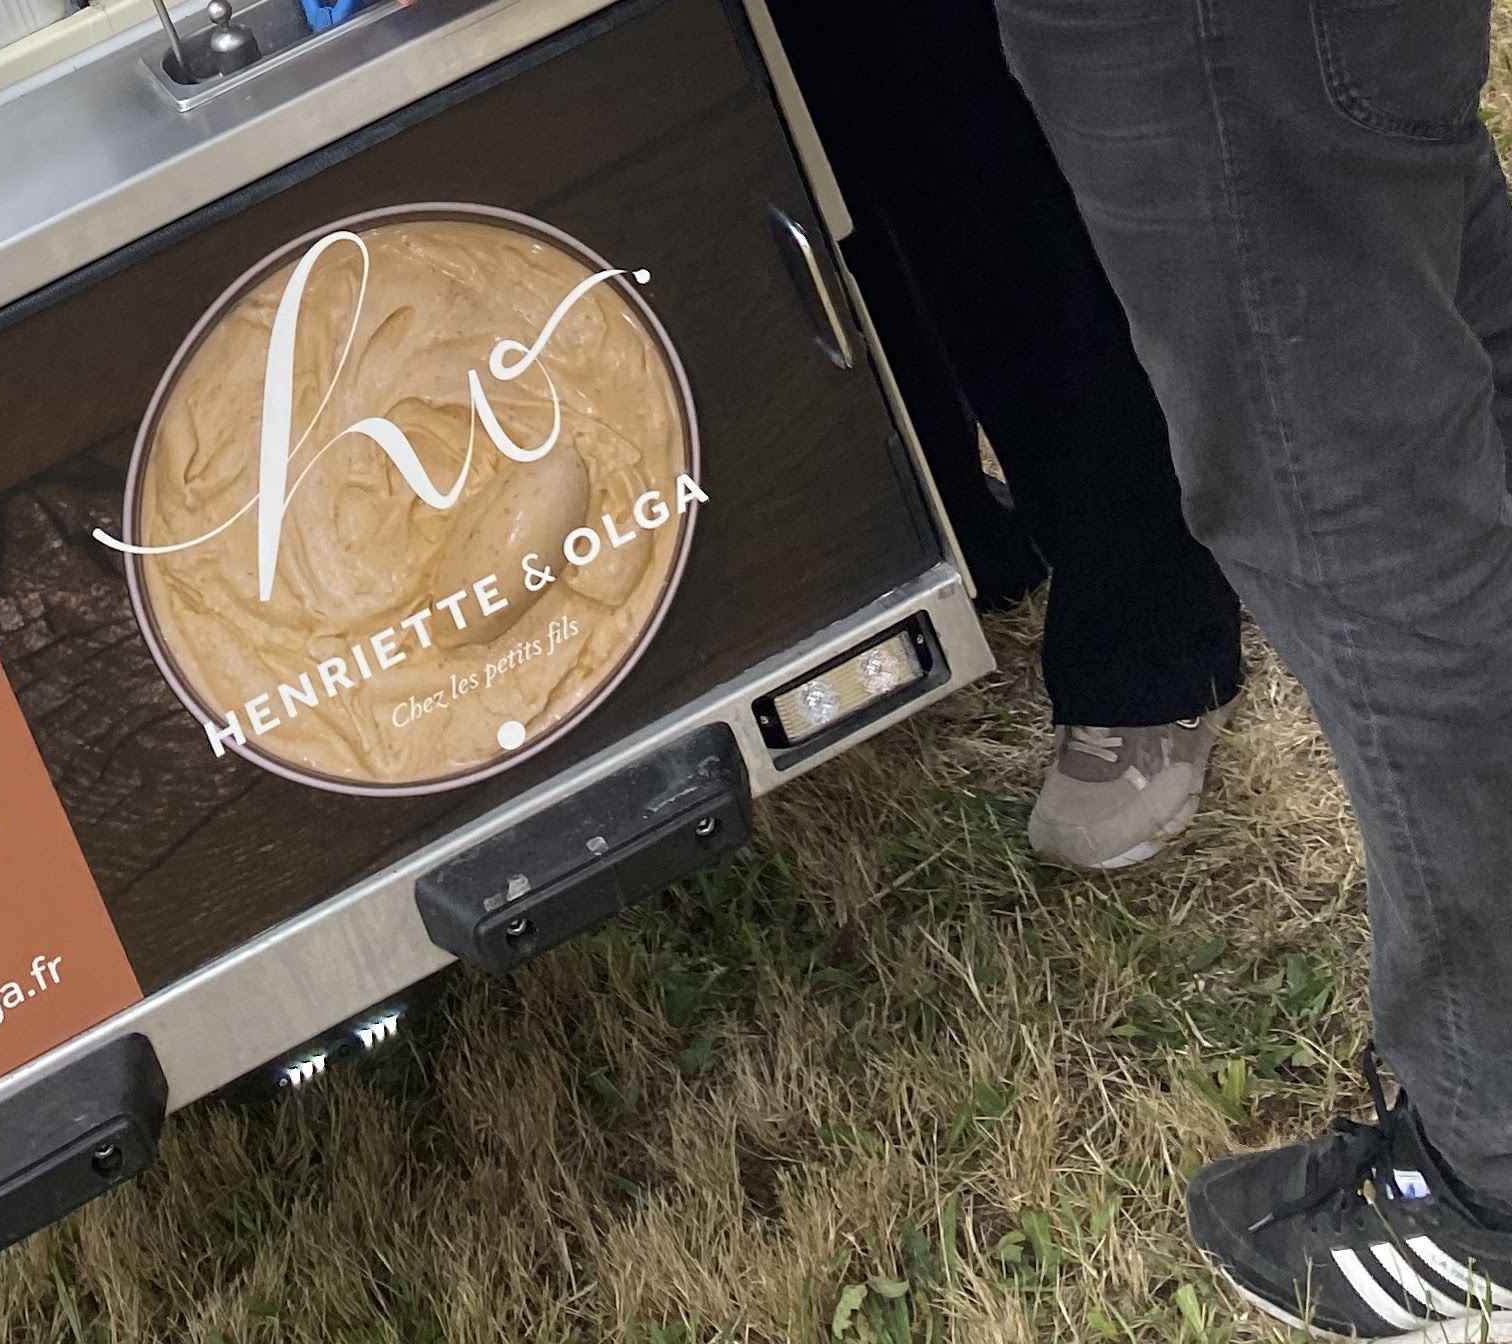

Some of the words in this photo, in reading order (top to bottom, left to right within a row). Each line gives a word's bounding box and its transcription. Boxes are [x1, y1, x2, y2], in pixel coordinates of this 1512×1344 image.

[202, 573, 508, 758] HENRIETTE
[522, 555, 557, 593] &
[563, 473, 709, 566] OLGA
[391, 689, 449, 729] Chez
[449, 672, 480, 700] les
[483, 639, 543, 689] petits
[546, 615, 580, 656] fils
